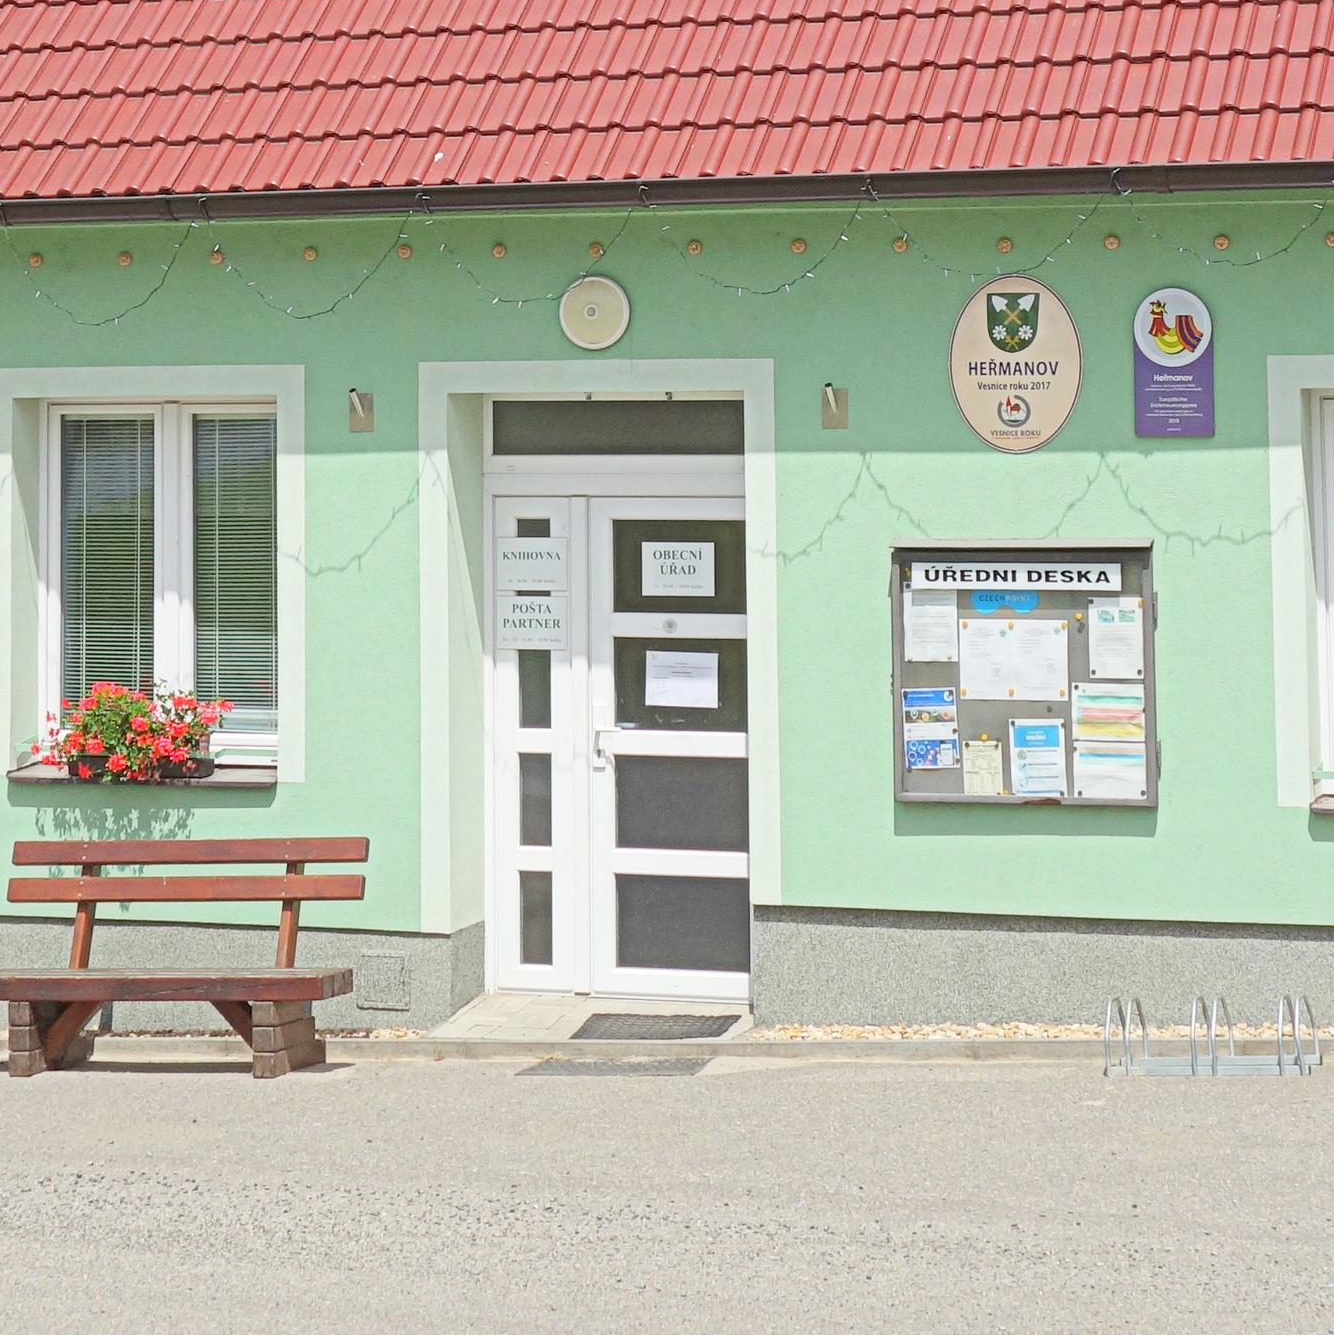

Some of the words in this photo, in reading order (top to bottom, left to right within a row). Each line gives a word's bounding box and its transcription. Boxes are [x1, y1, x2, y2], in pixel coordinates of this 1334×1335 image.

[968, 358, 1059, 376] HEŘMANOV
[977, 381, 1008, 390] Vesnice
[1009, 381, 1029, 390] roku
[1030, 381, 1051, 390] 2017
[502, 551, 561, 560] KNIHOVNA
[652, 547, 702, 561] OBECNÍ
[660, 561, 696, 575] ÚŘAD
[1027, 570, 1110, 584] DESKA
[512, 601, 552, 614] POŠTA
[503, 618, 561, 629] PARTNER
